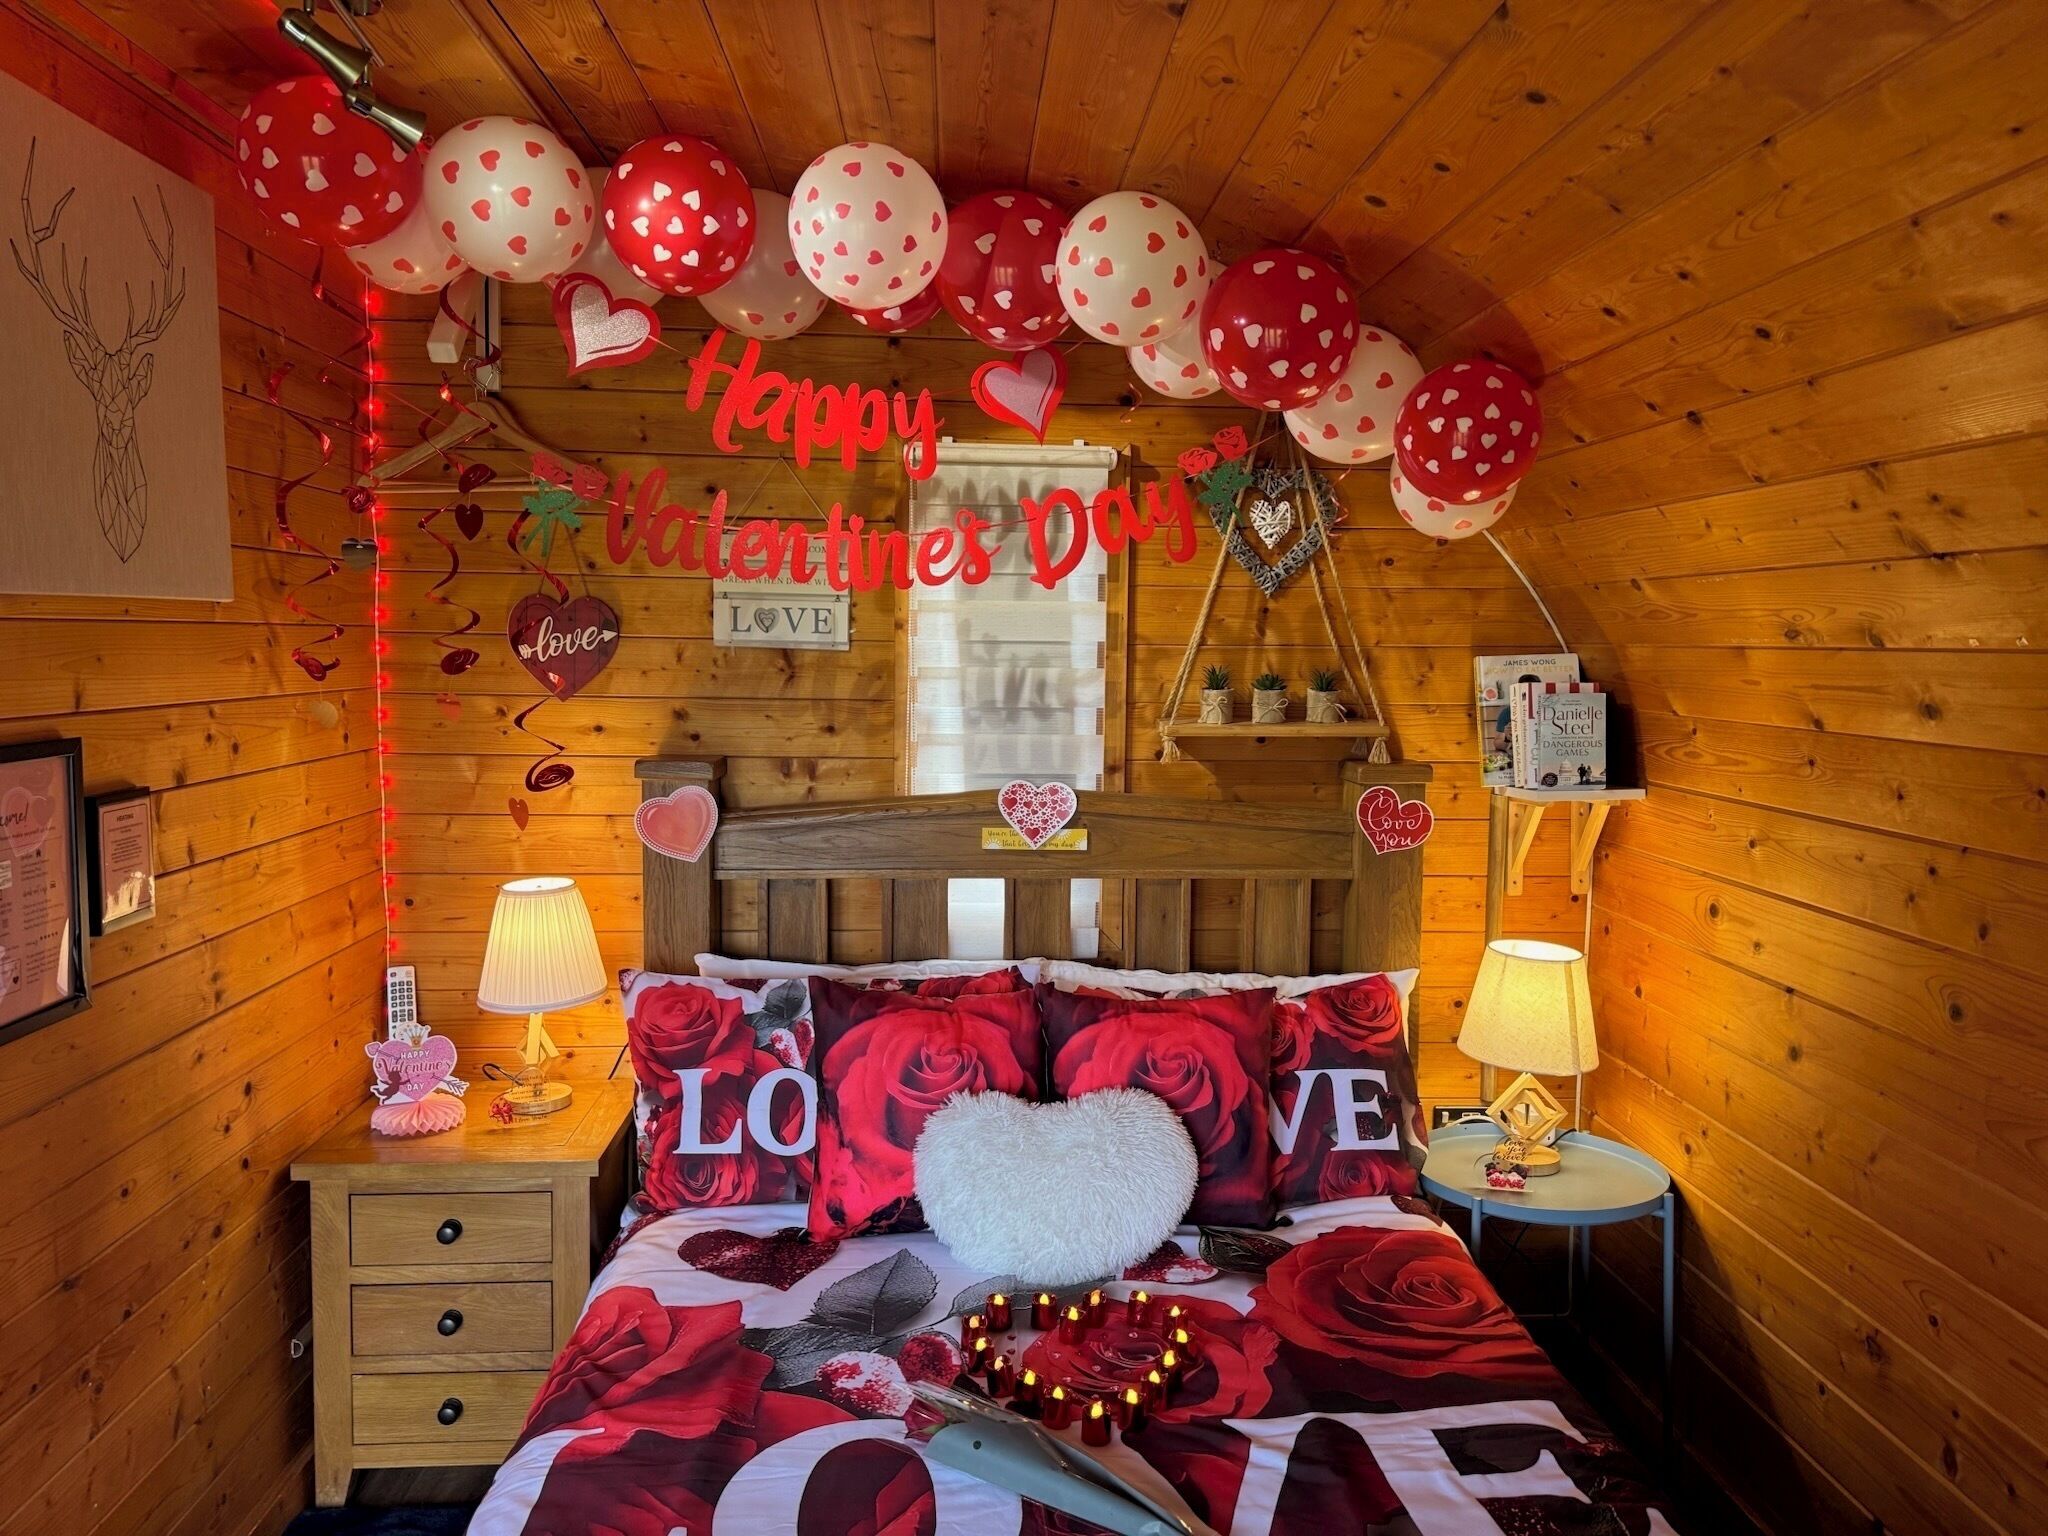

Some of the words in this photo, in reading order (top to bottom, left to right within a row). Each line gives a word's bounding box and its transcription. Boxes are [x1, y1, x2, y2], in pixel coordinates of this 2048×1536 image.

[685, 326, 945, 481] Happy
[1020, 474, 1198, 590] Day
[536, 615, 600, 662] love
[1503, 659, 1529, 667] JAMES
[1543, 705, 1603, 722] Danielle
[1551, 718, 1594, 735] Steel
[1543, 739, 1603, 749] DANGEROUS
[1555, 749, 1589, 757] GAMES
[400, 1050, 430, 1059] HAPPY
[406, 1083, 424, 1091] DAY
